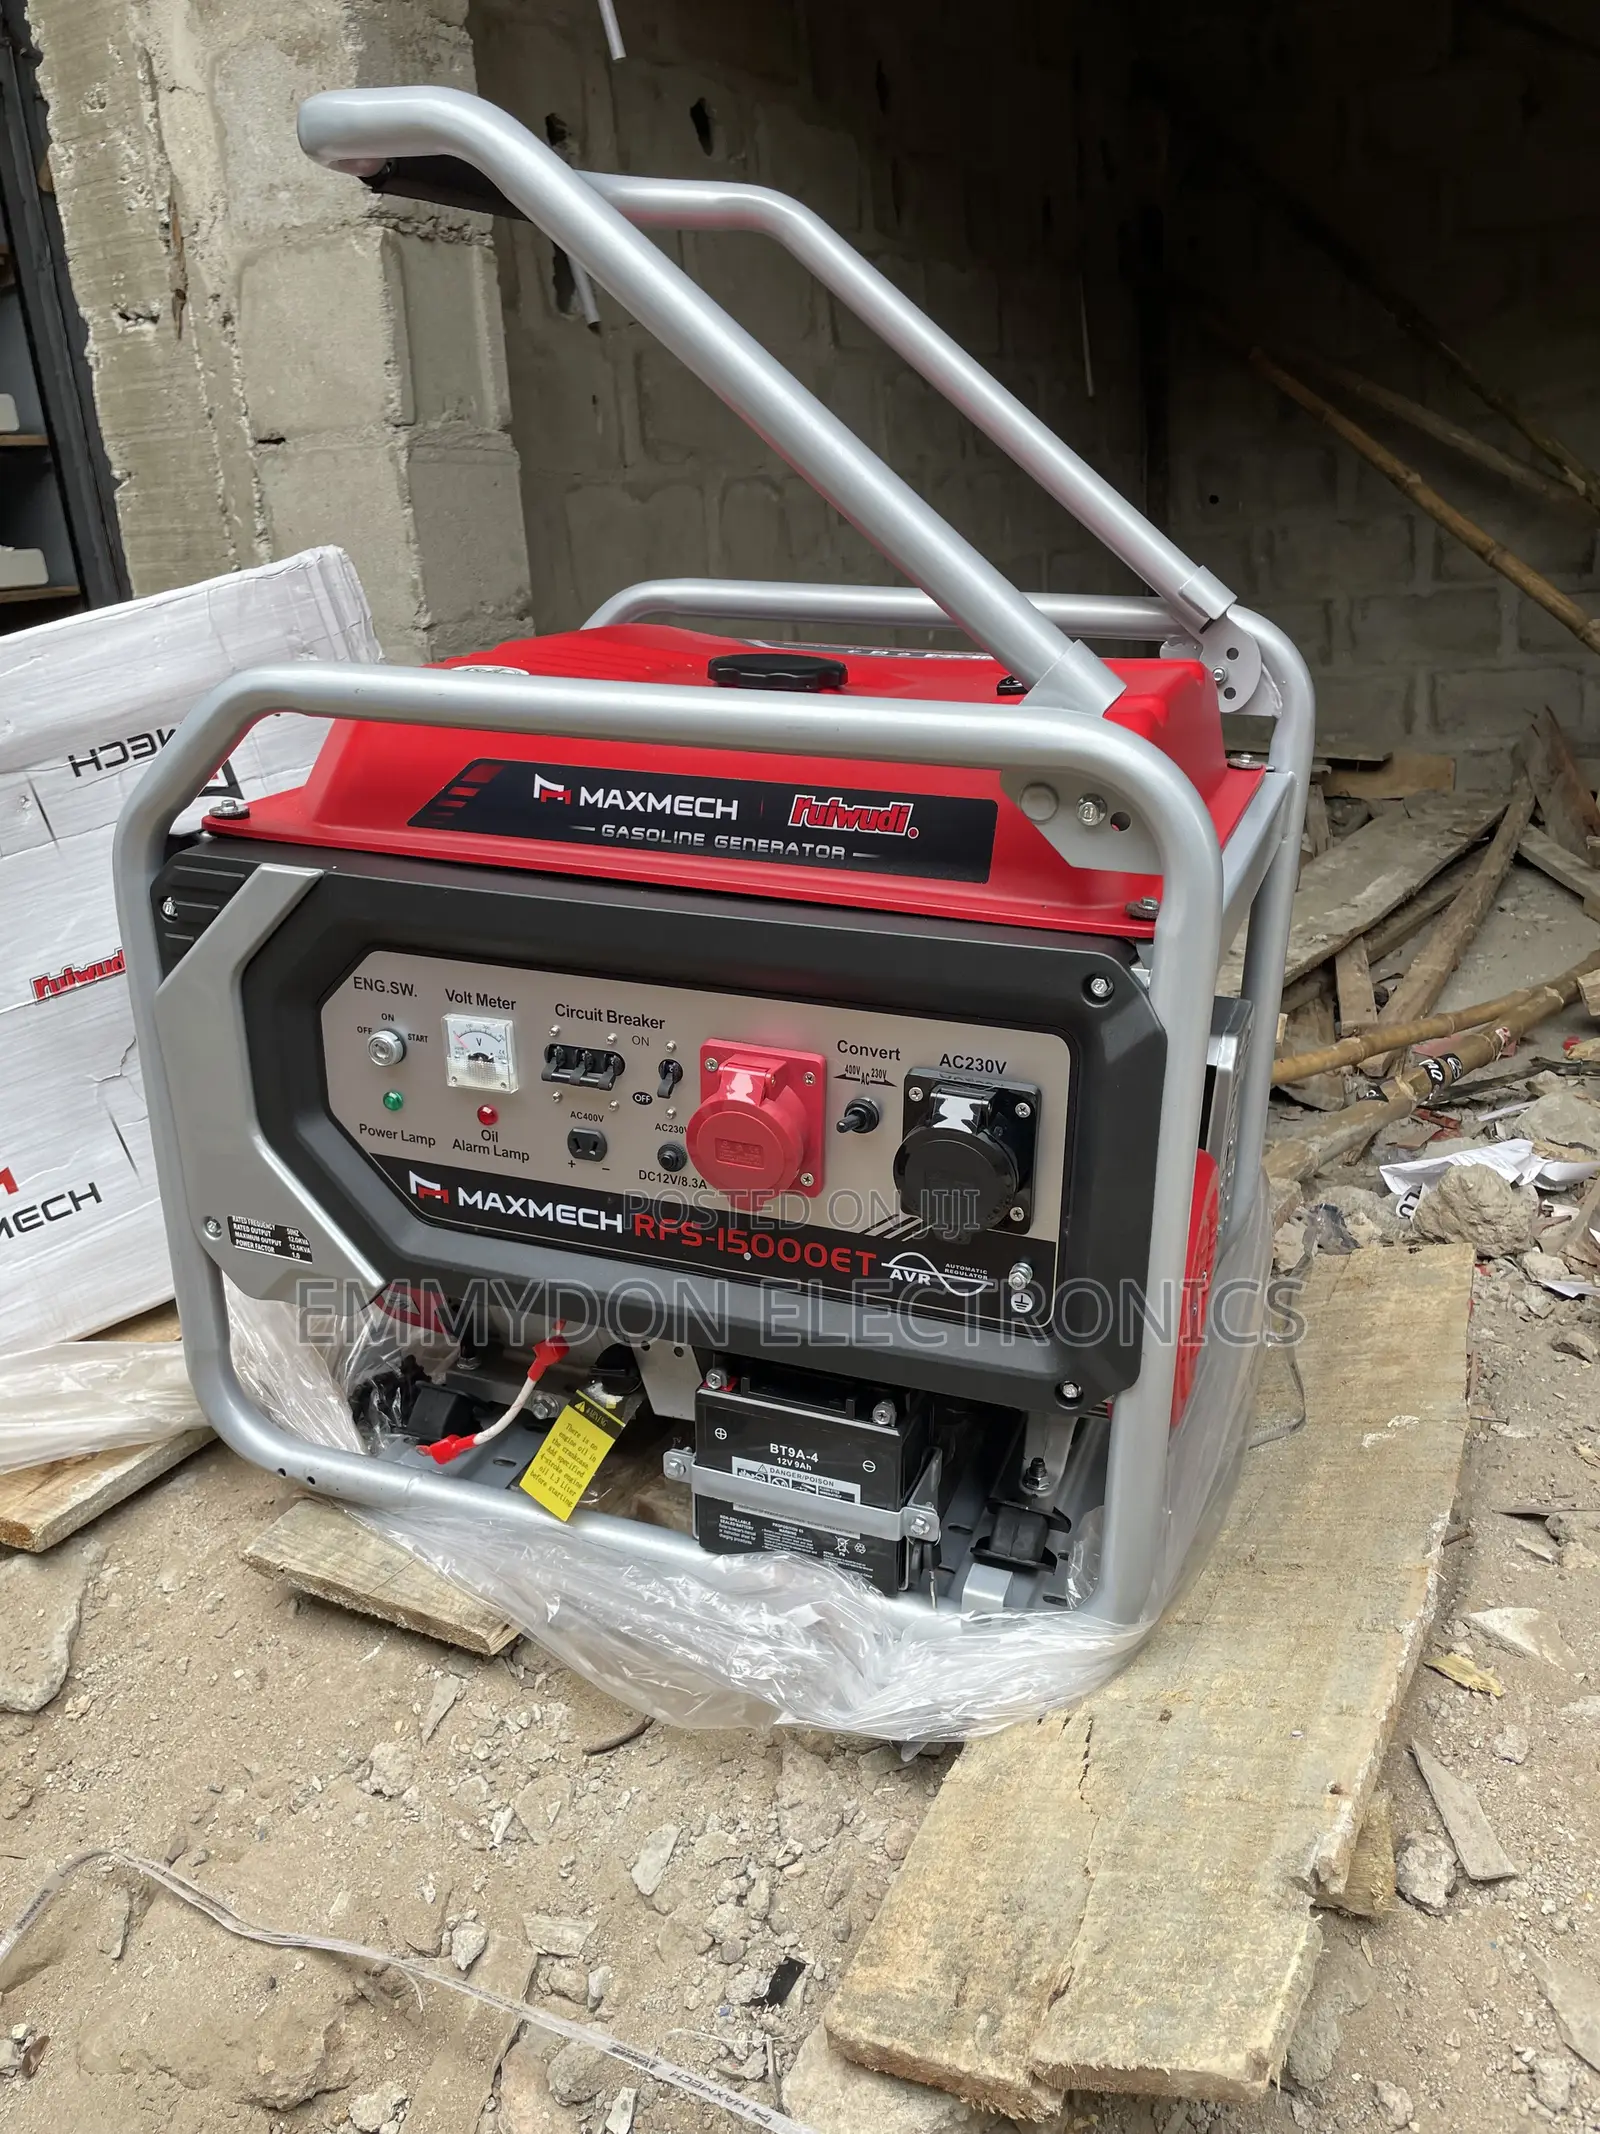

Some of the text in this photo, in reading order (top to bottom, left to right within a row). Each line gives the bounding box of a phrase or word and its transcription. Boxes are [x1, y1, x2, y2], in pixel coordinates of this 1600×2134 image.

[579, 786, 739, 821] MAXMECH
[601, 824, 846, 860] GASOLINE GENERATOR
[352, 976, 418, 998] ENG.SW.
[445, 988, 517, 1011] Volt Meter
[381, 1012, 395, 1022] ON
[554, 1003, 666, 1031] Circuit Breaker
[356, 1026, 373, 1035] OFF
[407, 1032, 429, 1044] START
[476, 1038, 482, 1046] V
[631, 1034, 650, 1047] ON
[837, 1039, 900, 1061] Convert
[844, 1064, 861, 1075] 400V
[939, 1053, 1007, 1075] AC230V
[860, 1072, 870, 1086] AC
[871, 1068, 887, 1080] 230V
[634, 1094, 651, 1103] OFF
[570, 1110, 605, 1123] AC400V
[358, 1123, 437, 1148] Power Lamp
[480, 1128, 499, 1143] Oil
[452, 1139, 530, 1163] Alarm Lamp
[638, 1169, 708, 1190] DC12V/8.3A
[458, 1186, 623, 1234] MAXMECH
[233, 1223, 250, 1233] RATED
[250, 1227, 272, 1237] OUTPUT
[254, 1243, 276, 1253] FACTOR
[260, 1236, 282, 1247] OUTPUT
[944, 1263, 988, 1275] AUTOMATIC
[944, 1268, 988, 1280] REGULATOR
[889, 1268, 931, 1286] AVR
[565, 1422, 582, 1438] There
[552, 1438, 562, 1448] the
[558, 1432, 577, 1448] engine
[769, 1443, 819, 1463] BT9A-4
[776, 1457, 812, 1471] 12V 9Ah
[769, 1467, 835, 1487] DANGER/POISON
[669, 2070, 750, 2112] MAXMECH
